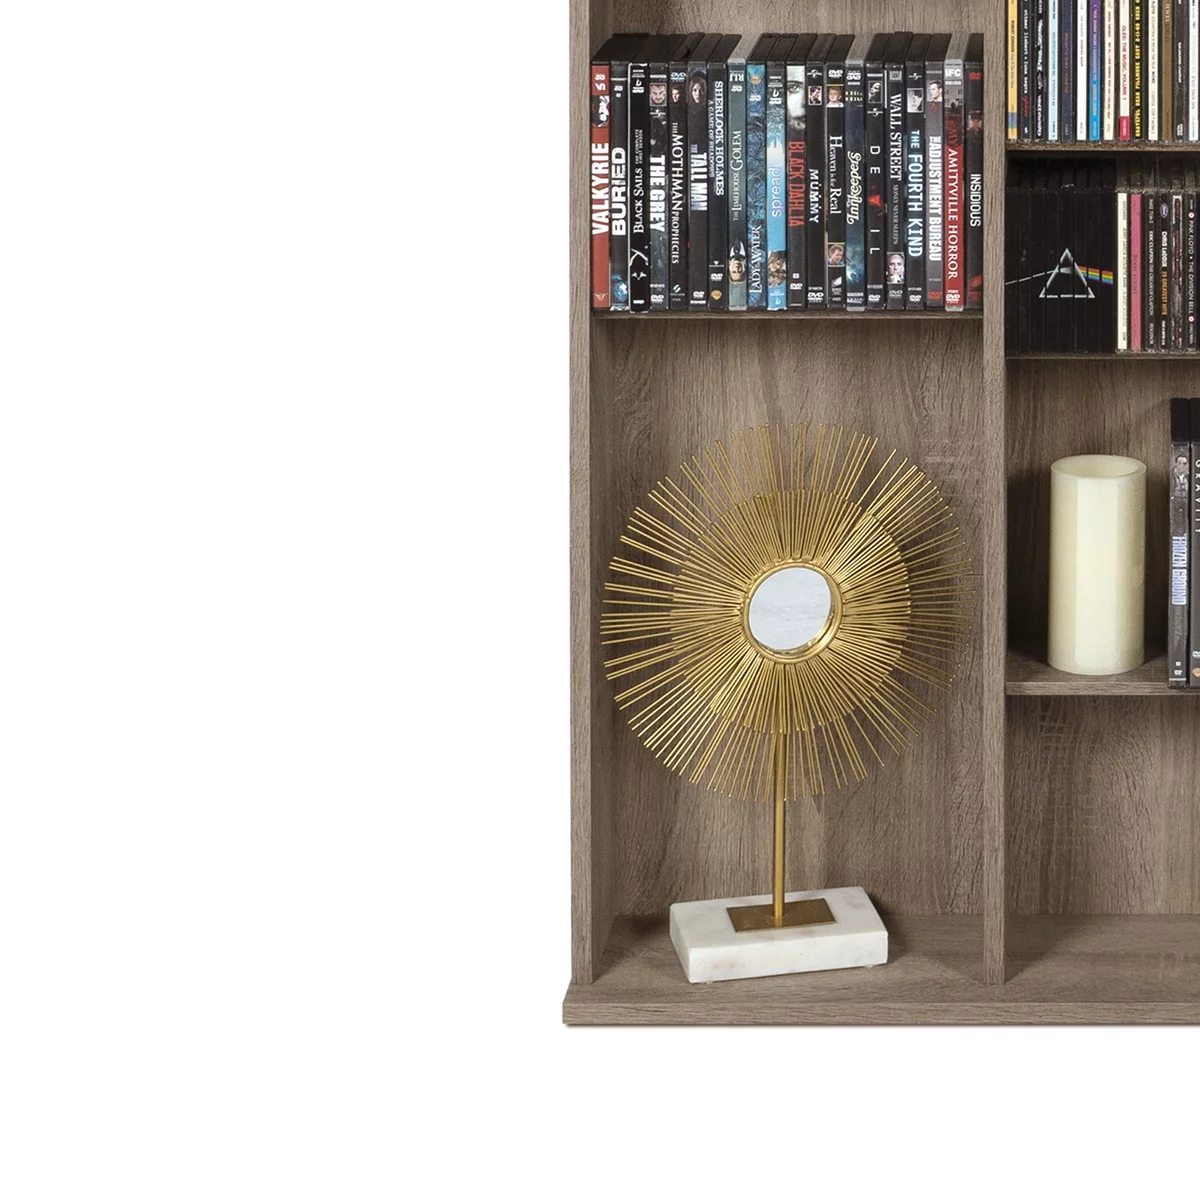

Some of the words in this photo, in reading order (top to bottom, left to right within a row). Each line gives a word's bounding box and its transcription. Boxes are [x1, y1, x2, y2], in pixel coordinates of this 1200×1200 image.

[715, 81, 724, 144] SHERLOCK
[890, 94, 901, 129] WALL
[830, 136, 842, 171] Heaven
[890, 132, 902, 180] STREET
[911, 130, 919, 148] THE
[634, 168, 644, 196] SAILS
[650, 155, 665, 187] THE
[671, 134, 683, 210] MOTHMAN
[691, 153, 706, 181] TALL
[715, 146, 724, 195] HOLMES
[788, 142, 804, 180] BLACK
[592, 144, 608, 235] VALKYRIE
[611, 148, 626, 235] BURIED
[691, 183, 706, 210] MAN
[771, 167, 783, 216] spread
[830, 188, 842, 214] Real
[908, 155, 922, 211] FOURTH
[948, 149, 958, 221] AMITYVILLE
[970, 174, 980, 226] INSIDIOUS
[634, 199, 644, 233] BLACK
[650, 190, 665, 232] GREY
[789, 184, 805, 226] DAHLIA
[908, 219, 922, 257] KIND
[948, 225, 958, 279] HORROR
